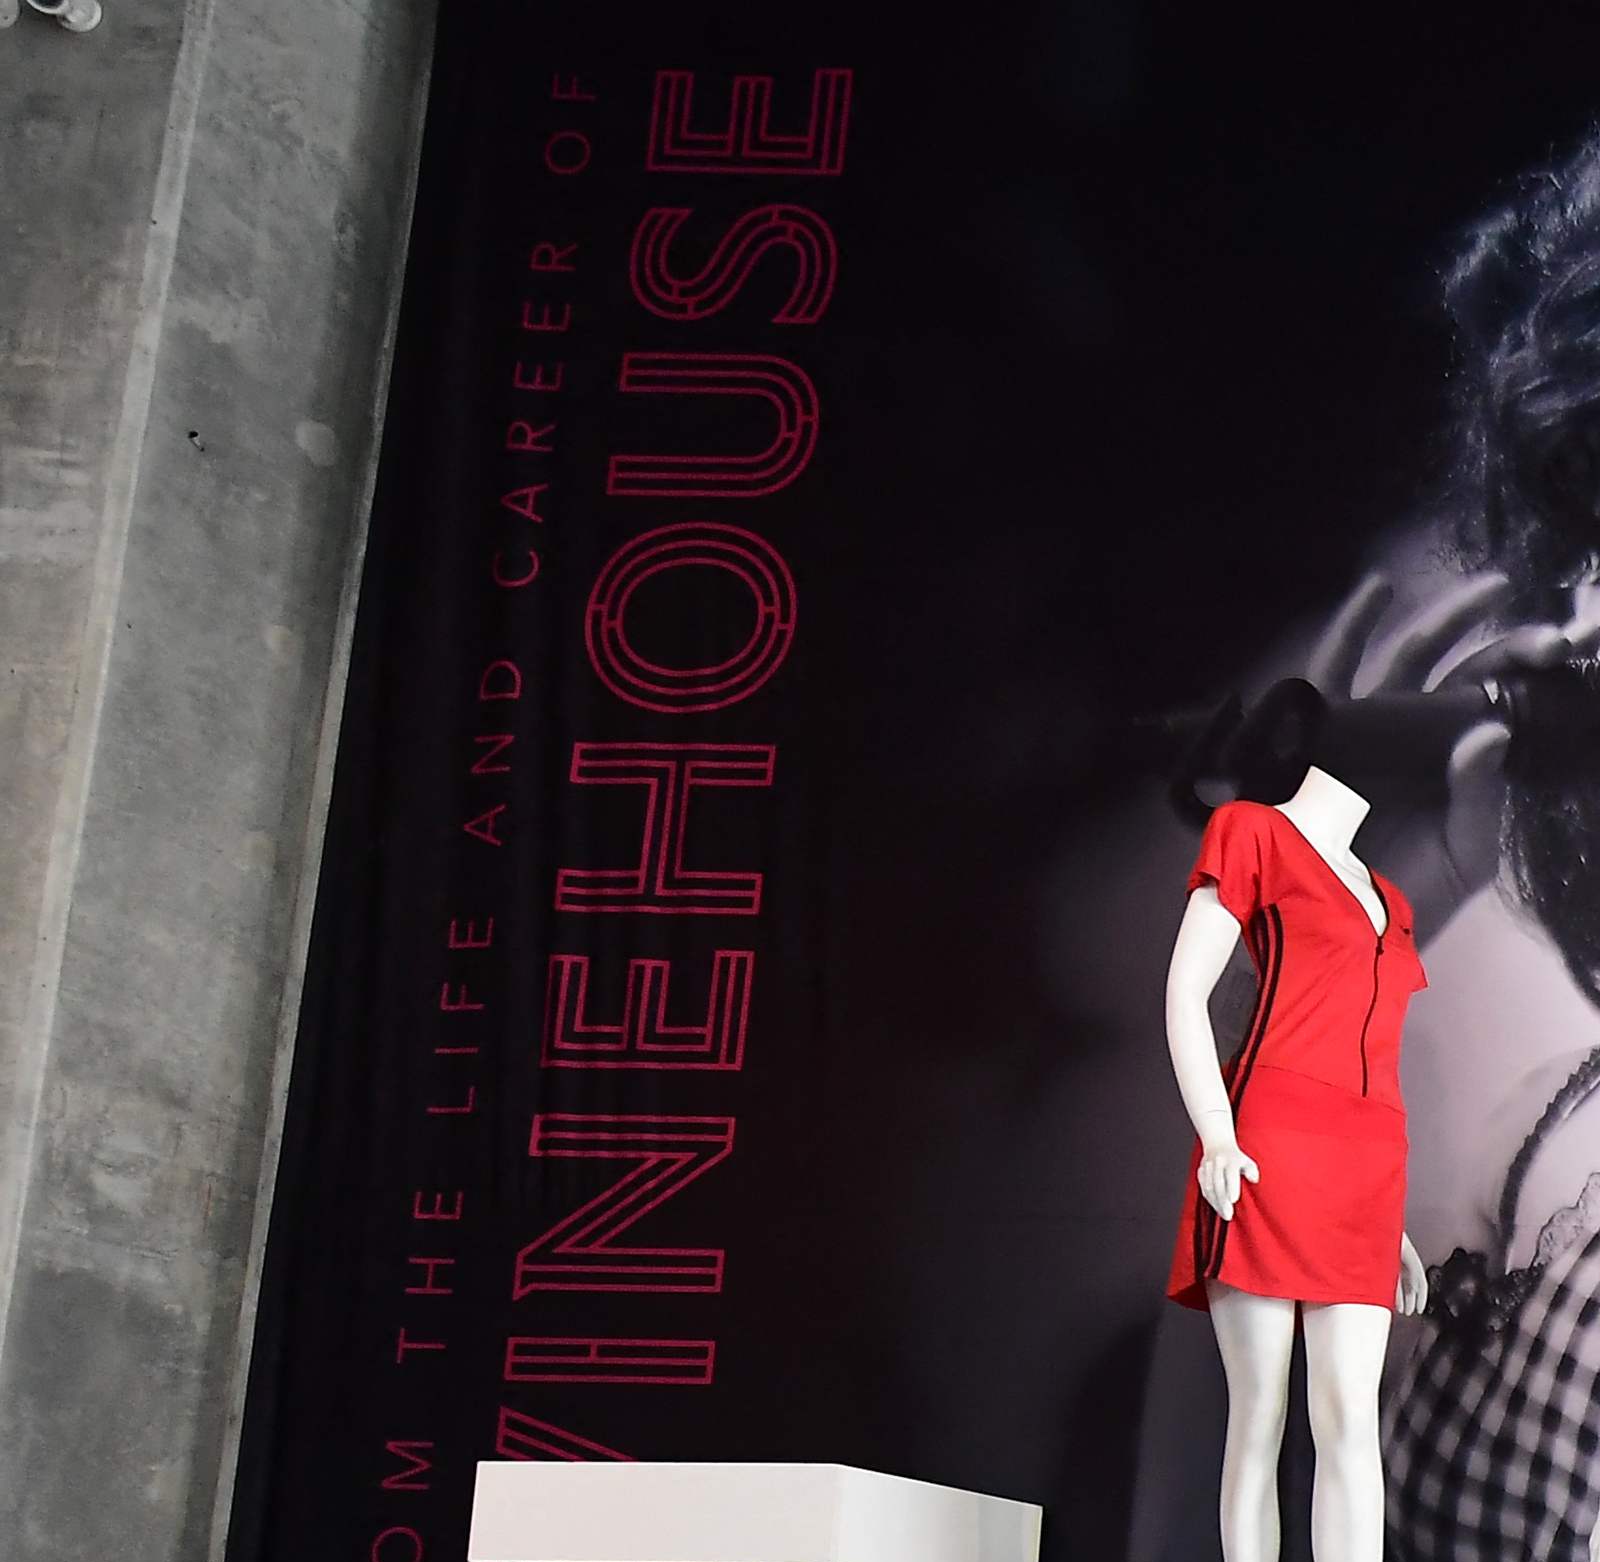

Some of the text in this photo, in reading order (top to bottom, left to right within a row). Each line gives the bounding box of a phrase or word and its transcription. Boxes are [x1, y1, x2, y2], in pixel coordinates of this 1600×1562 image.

[544, 73, 597, 176] OF
[494, 240, 579, 588] CAREER
[463, 658, 523, 846] AND
[427, 917, 495, 1114] LIFE
[396, 1191, 463, 1364] THE
